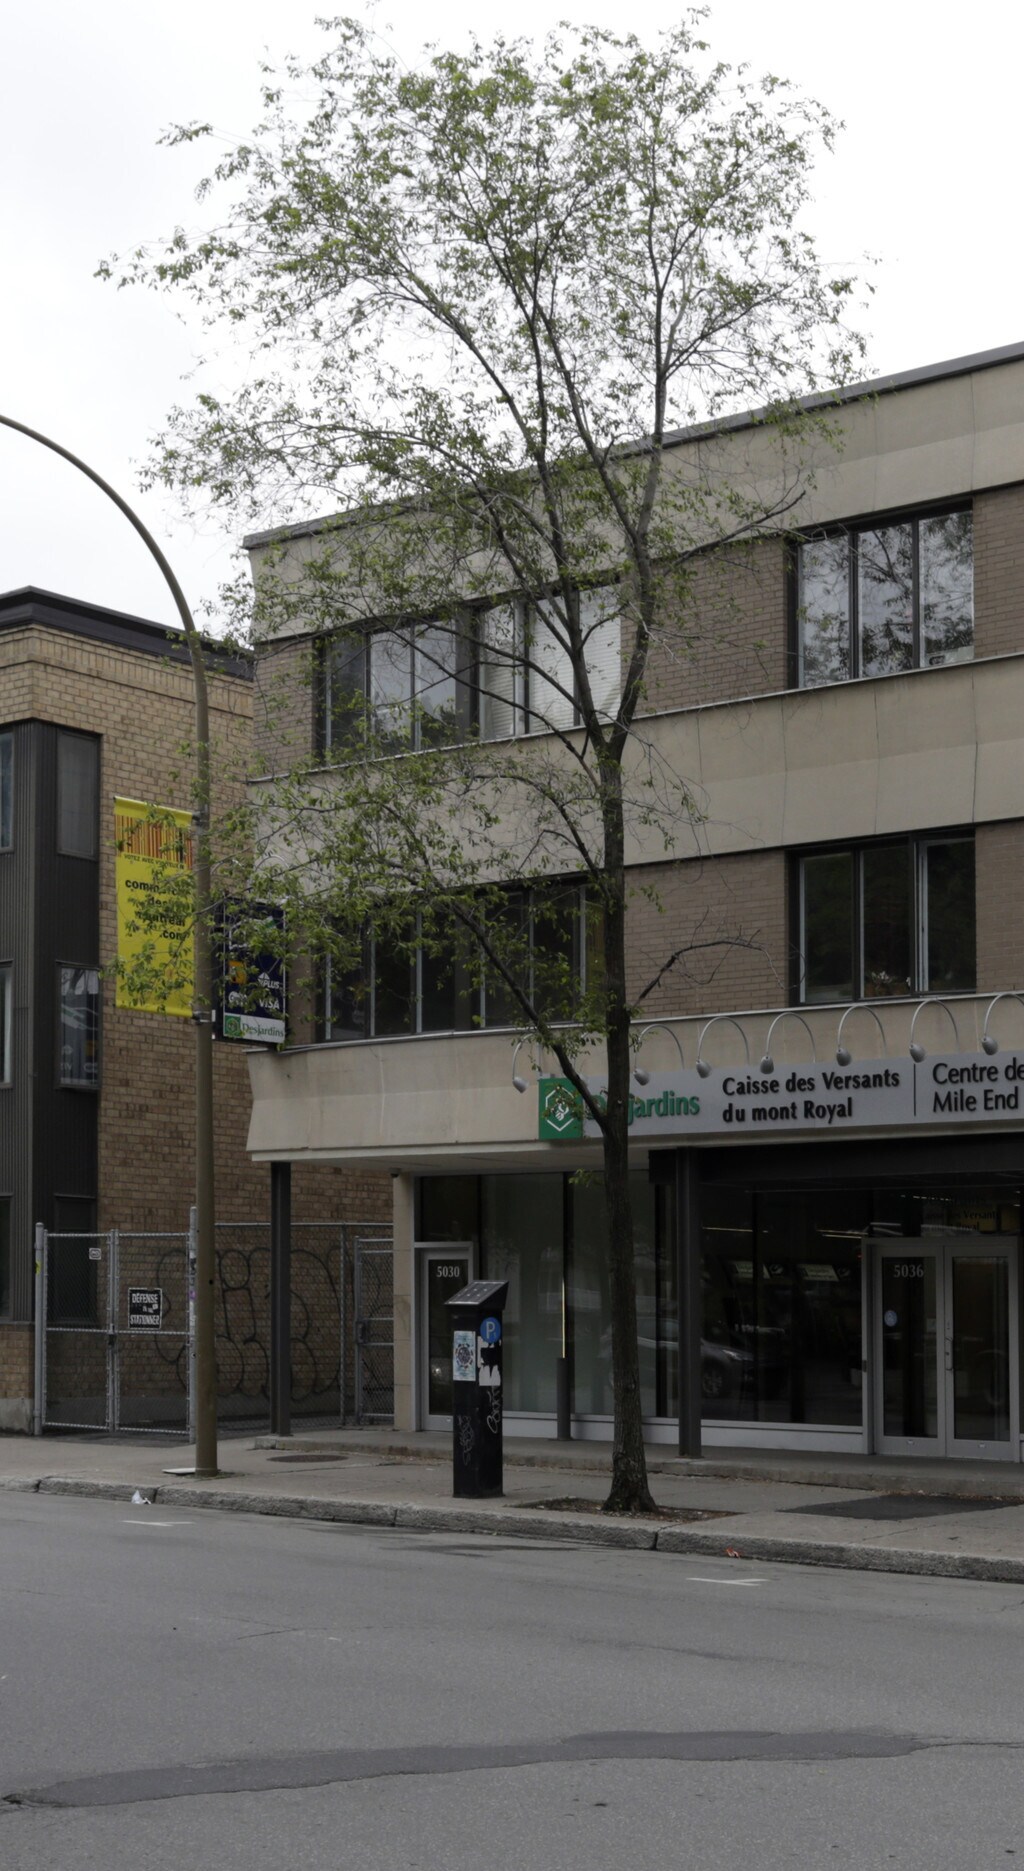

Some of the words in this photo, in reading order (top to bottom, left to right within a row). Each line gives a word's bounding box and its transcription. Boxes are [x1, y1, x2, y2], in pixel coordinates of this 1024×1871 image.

[263, 979, 280, 989] PLUS
[259, 998, 280, 1009] VISA
[242, 1022, 284, 1037] Desjardins
[932, 1062, 998, 1084] Centre
[722, 1075, 779, 1096] Caisse
[785, 1072, 815, 1092] des
[822, 1069, 900, 1090] Versants
[933, 1089, 977, 1113] Mile
[984, 1086, 1018, 1111] End
[722, 1103, 745, 1123] du
[752, 1102, 797, 1121] mont
[804, 1097, 852, 1124] Royal
[436, 1265, 460, 1278] 5030
[893, 1263, 924, 1278] 5036
[131, 1293, 158, 1303] DÉFENSE
